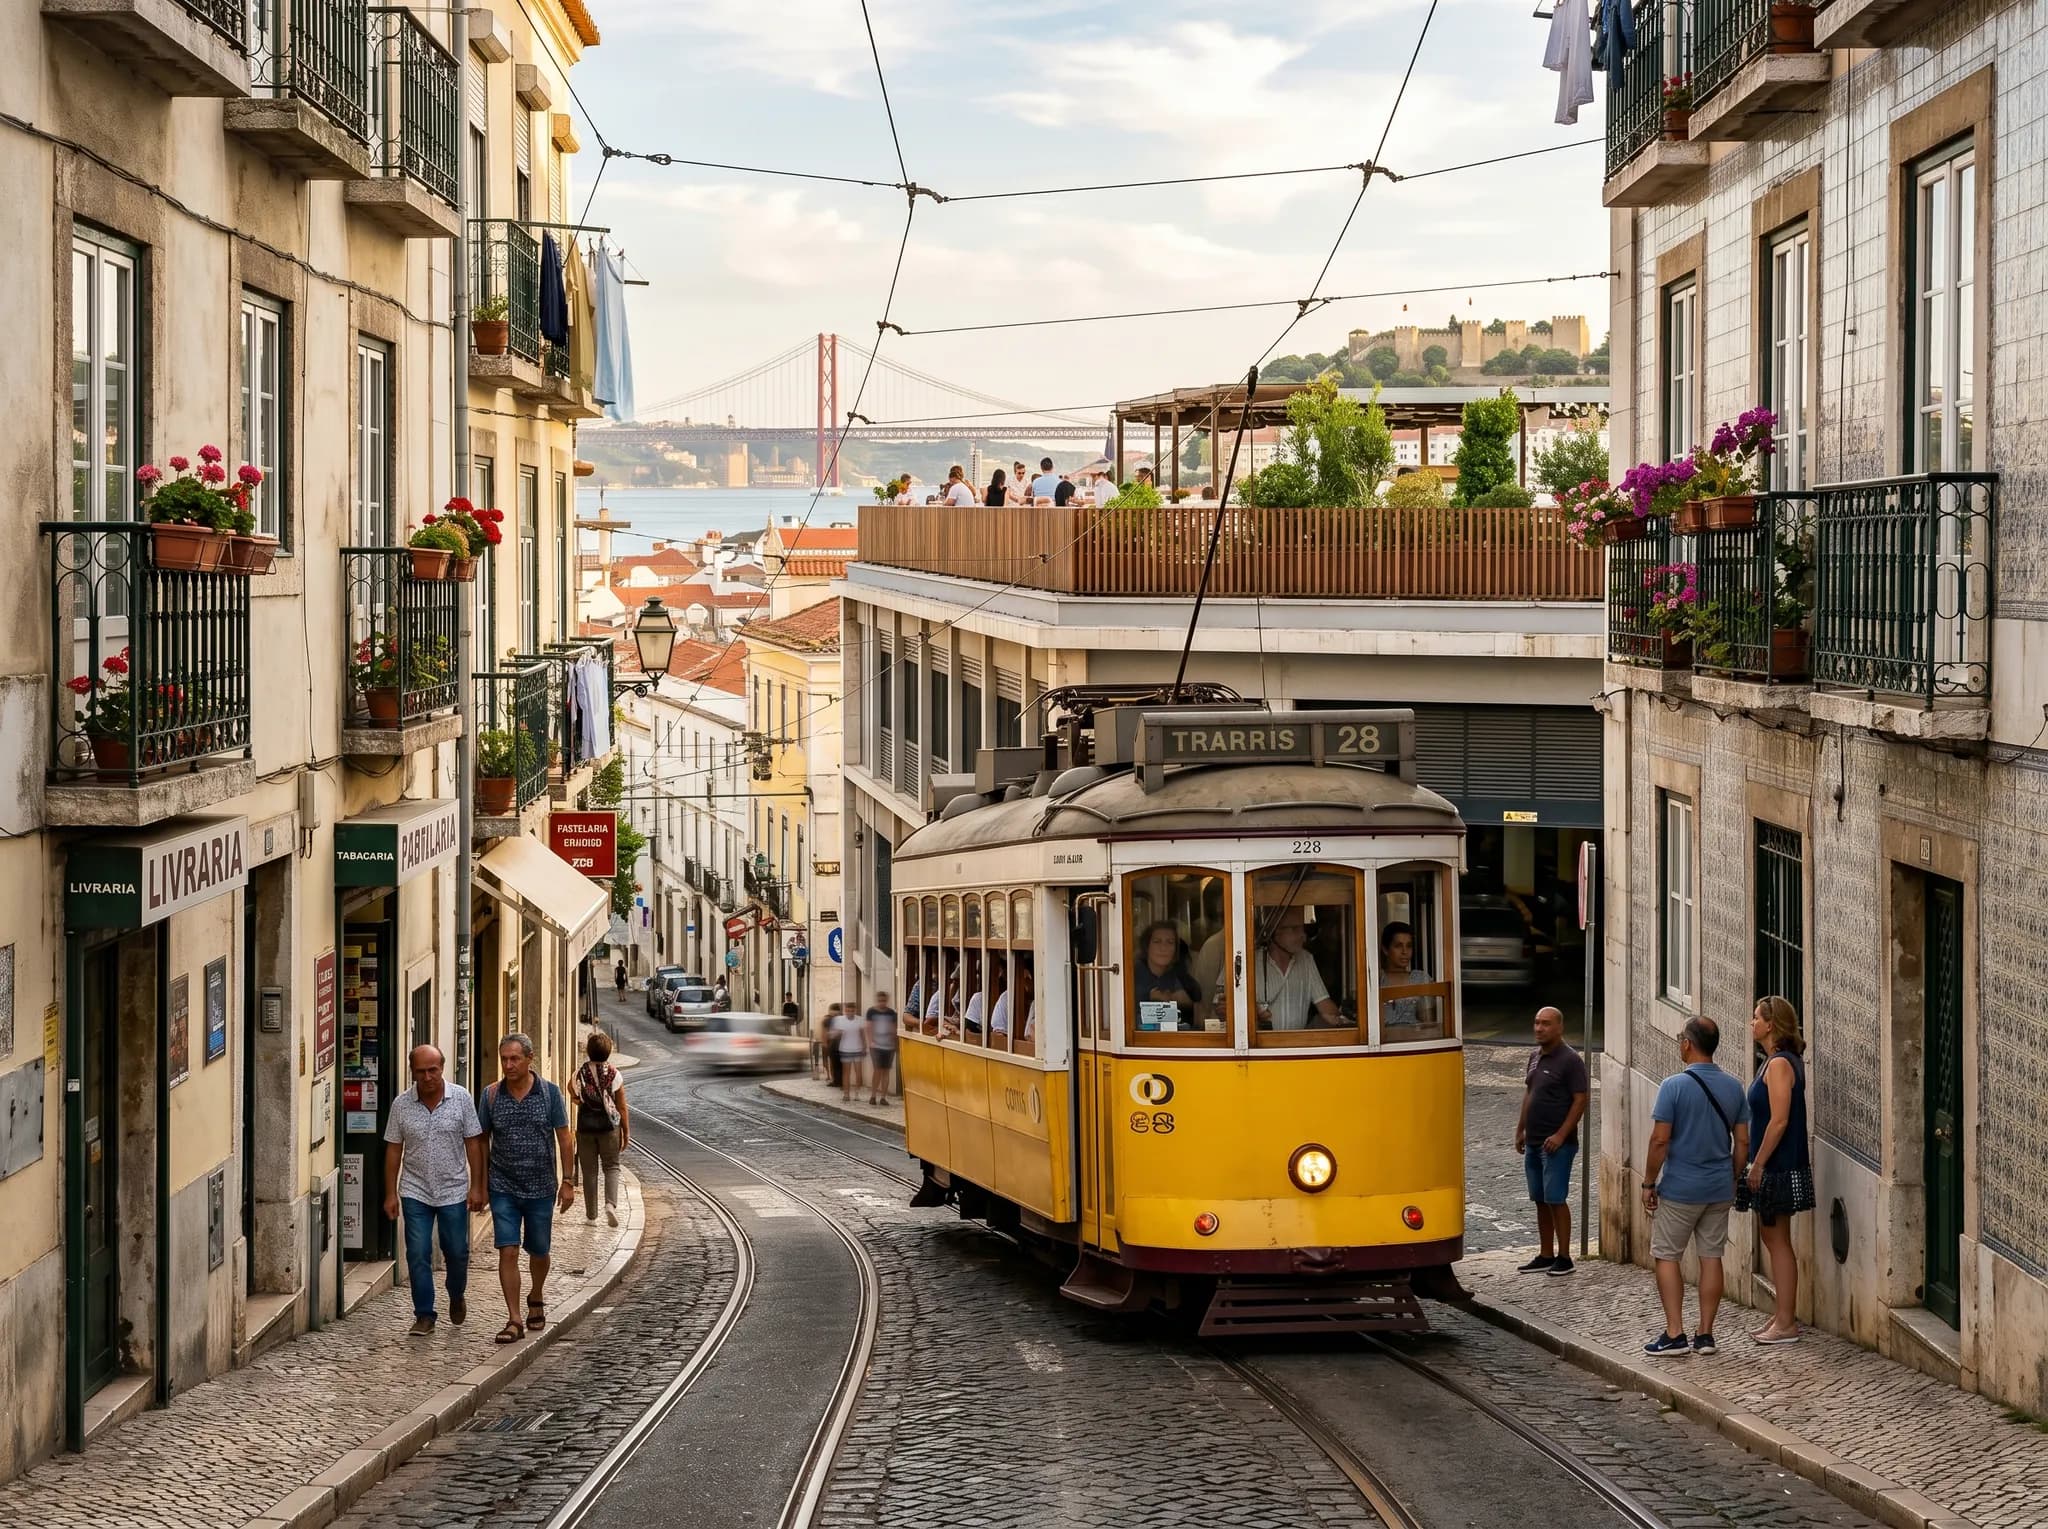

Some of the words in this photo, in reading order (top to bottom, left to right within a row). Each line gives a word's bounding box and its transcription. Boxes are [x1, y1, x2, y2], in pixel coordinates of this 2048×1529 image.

[1172, 729, 1295, 752] TRARRIS
[1337, 725, 1380, 754] 28
[1292, 840, 1321, 854] 228
[337, 851, 394, 861] TABACARIA
[149, 830, 243, 910] LIVRARIA
[70, 882, 136, 894] LIVRARIA
